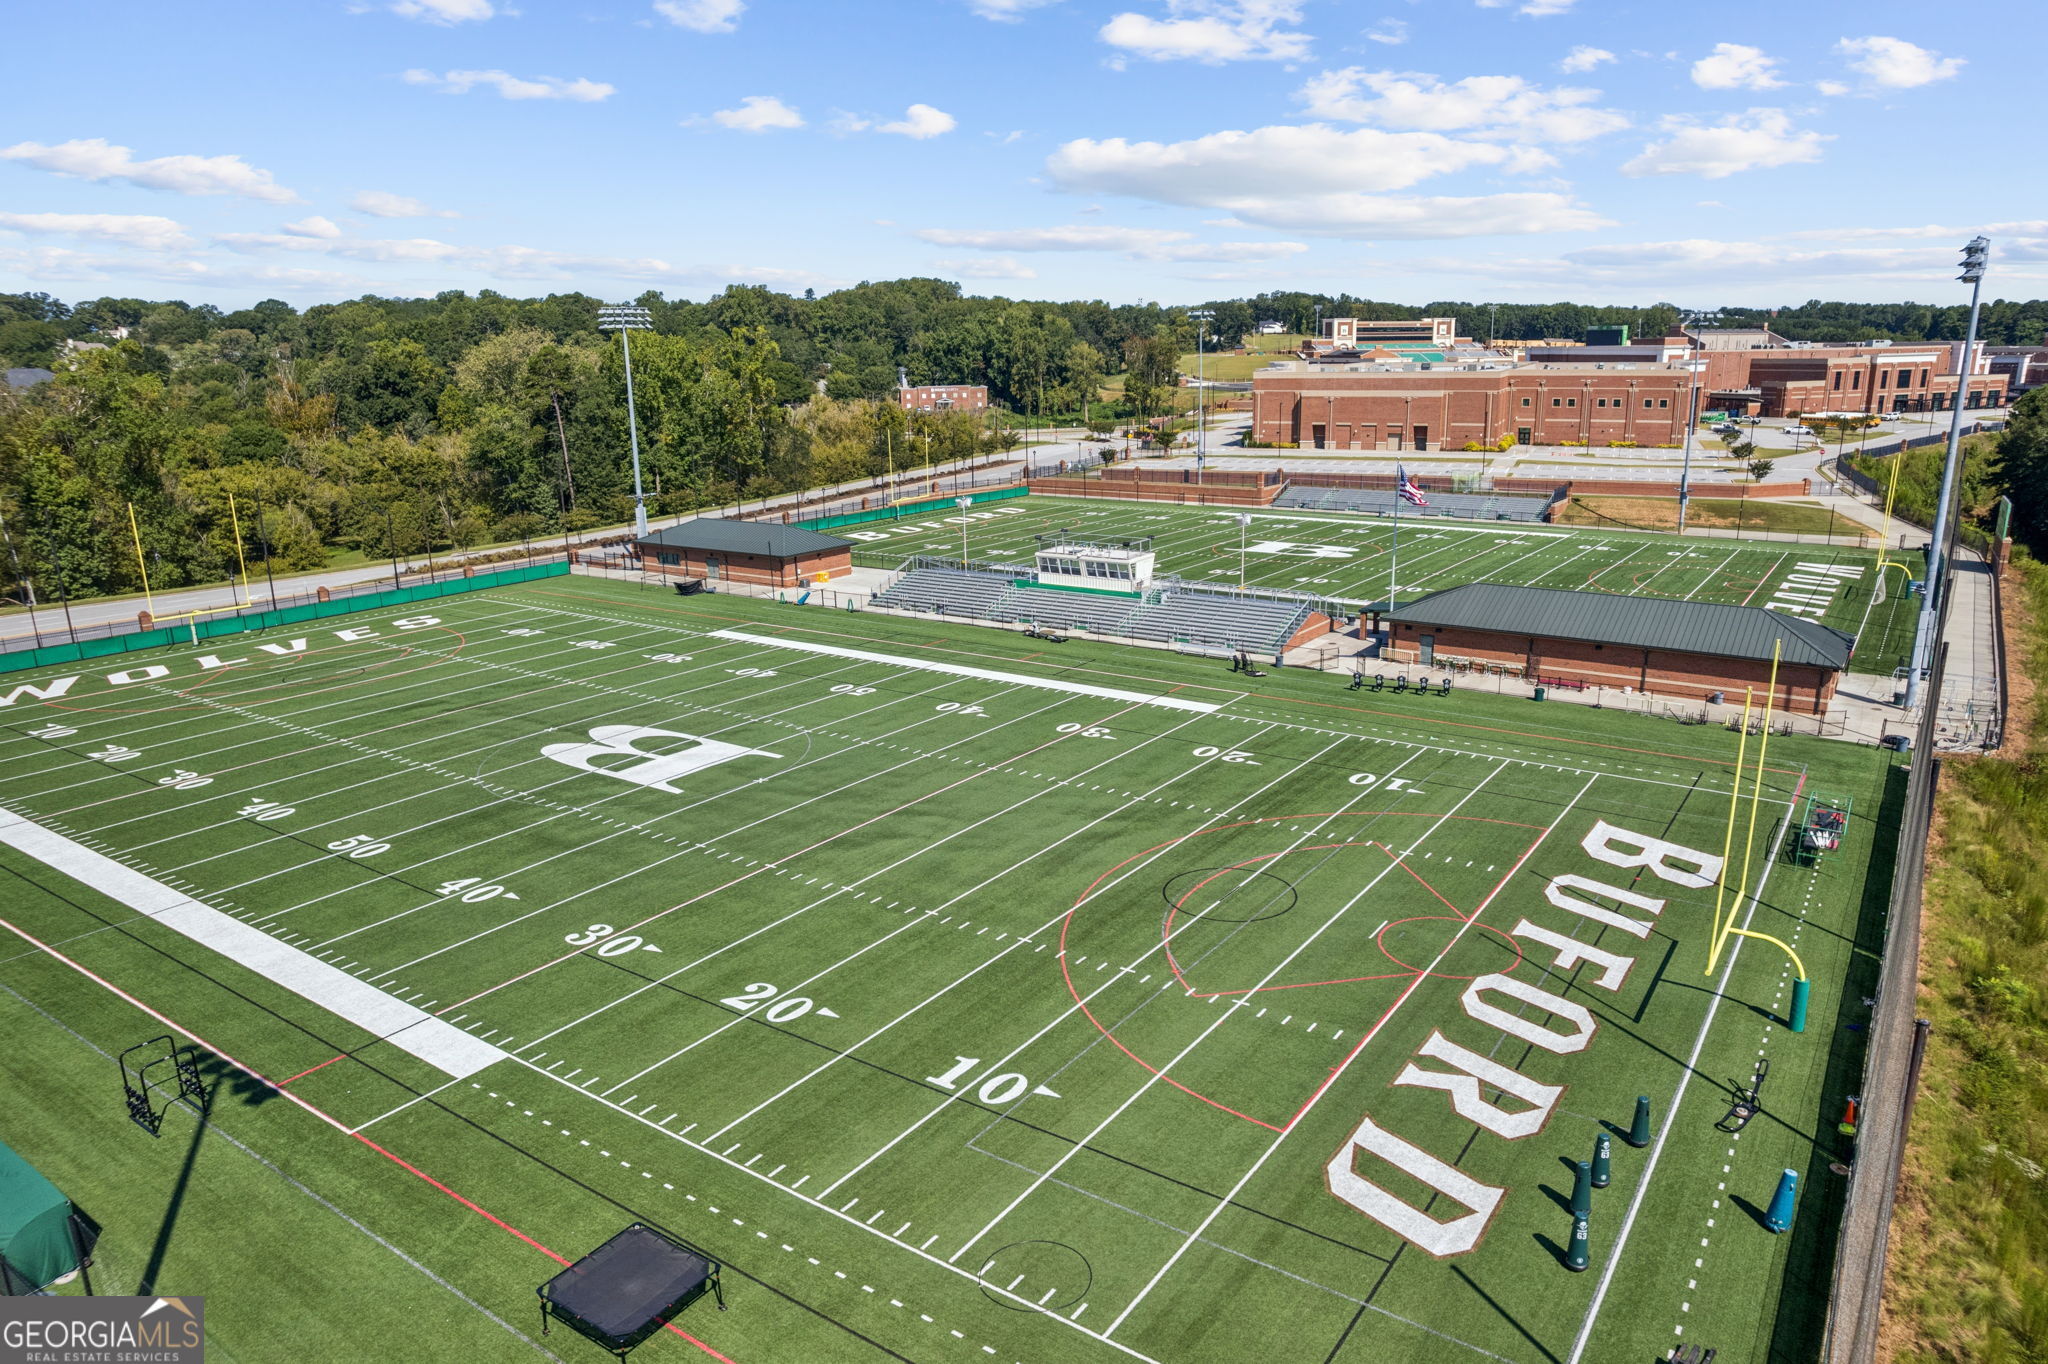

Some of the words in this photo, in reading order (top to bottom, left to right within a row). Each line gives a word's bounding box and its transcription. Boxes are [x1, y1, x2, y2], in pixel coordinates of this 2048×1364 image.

[844, 508, 1026, 541] BUFORD
[1764, 562, 1865, 624] WOLVE
[0, 615, 442, 707] WOLVES
[830, 684, 877, 696] 50
[935, 702, 984, 715] 40
[27, 724, 78, 739] 10
[1055, 722, 1110, 738] 30
[87, 747, 141, 762] 20
[540, 725, 784, 794] B
[1192, 746, 1254, 763] 20
[158, 770, 214, 790] 30
[1348, 773, 1412, 791] 10
[236, 802, 296, 821] 40
[327, 834, 391, 859] 50
[435, 877, 504, 903] 40
[564, 924, 643, 957] 30
[720, 983, 813, 1023] 20
[1323, 818, 1729, 1258] BUFORD
[925, 1055, 1028, 1104] 10
